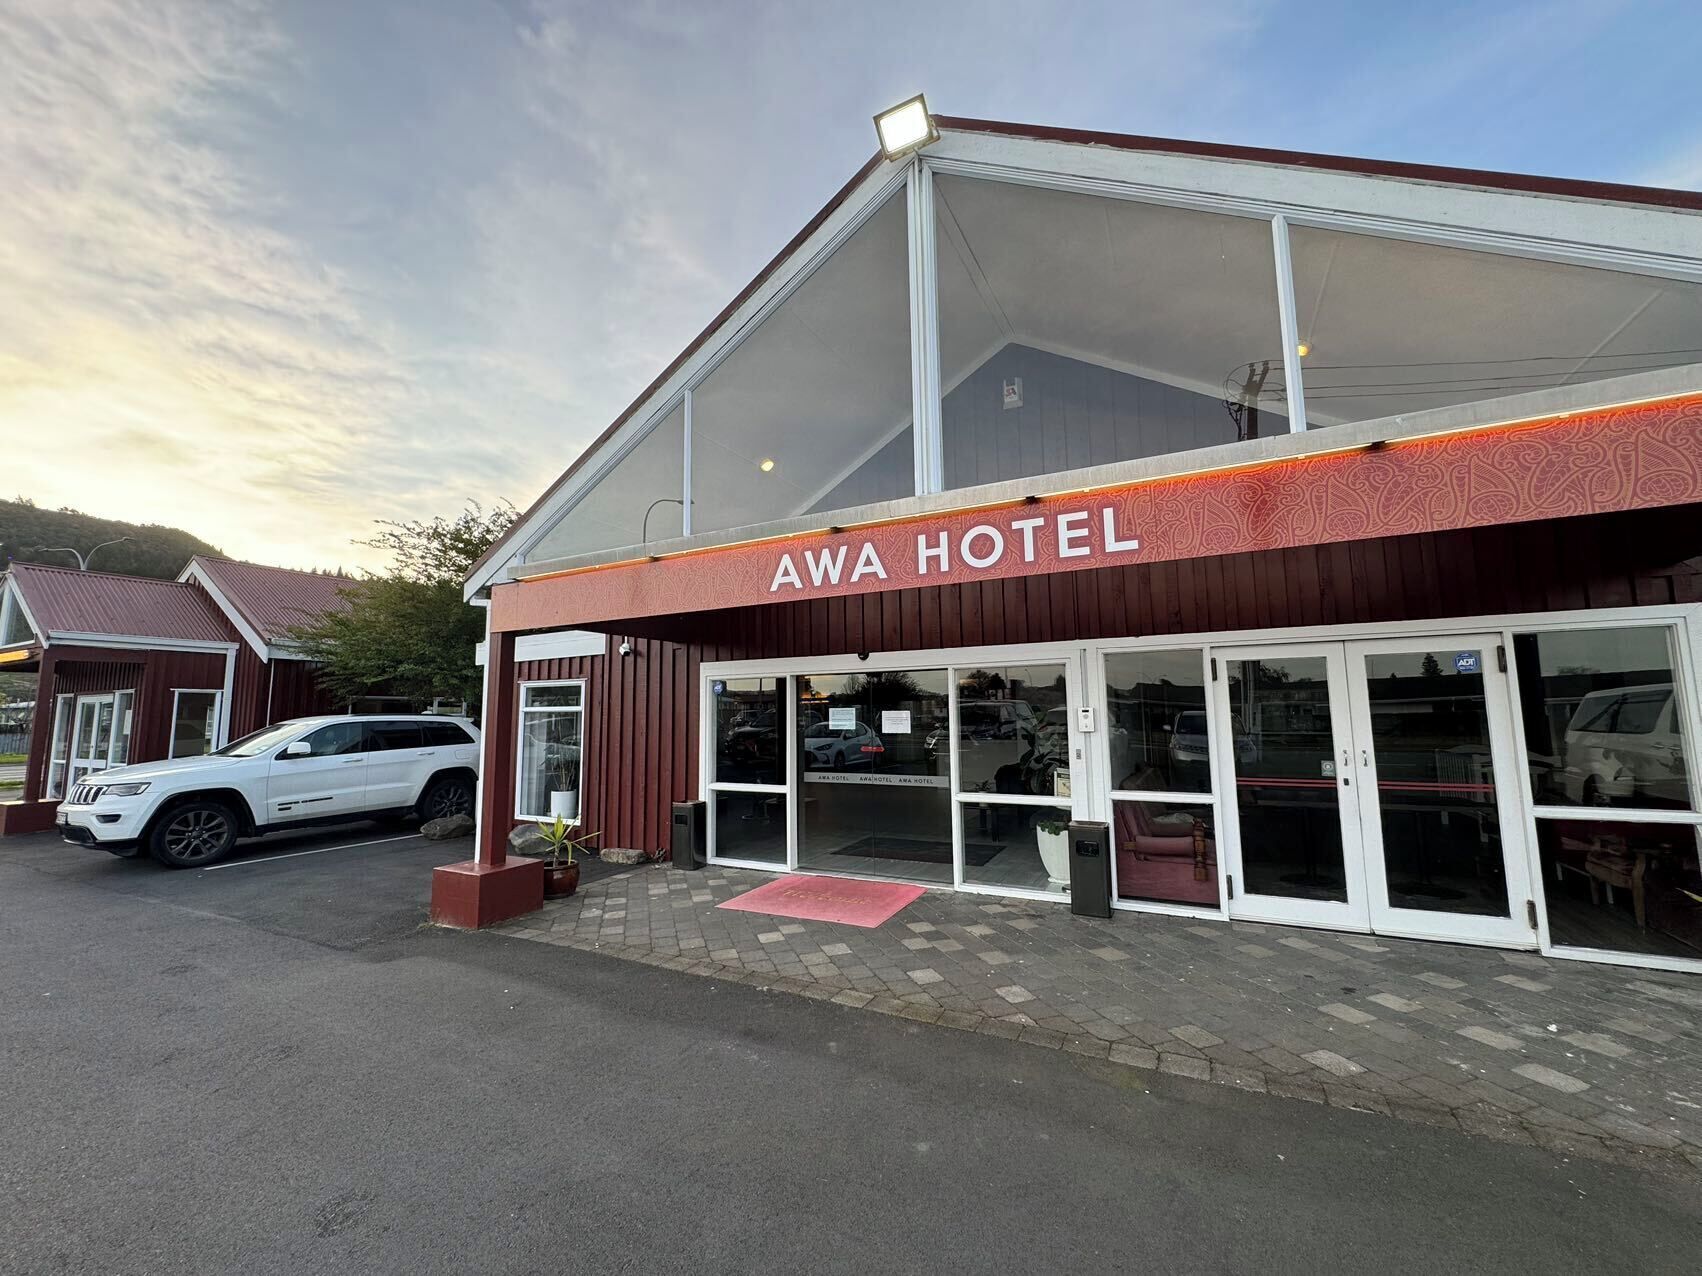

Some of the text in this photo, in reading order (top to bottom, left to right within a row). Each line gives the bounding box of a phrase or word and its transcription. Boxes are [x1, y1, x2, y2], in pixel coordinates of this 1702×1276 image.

[769, 507, 1139, 592] AWA HOTEL
[1458, 658, 1475, 666] ADT
